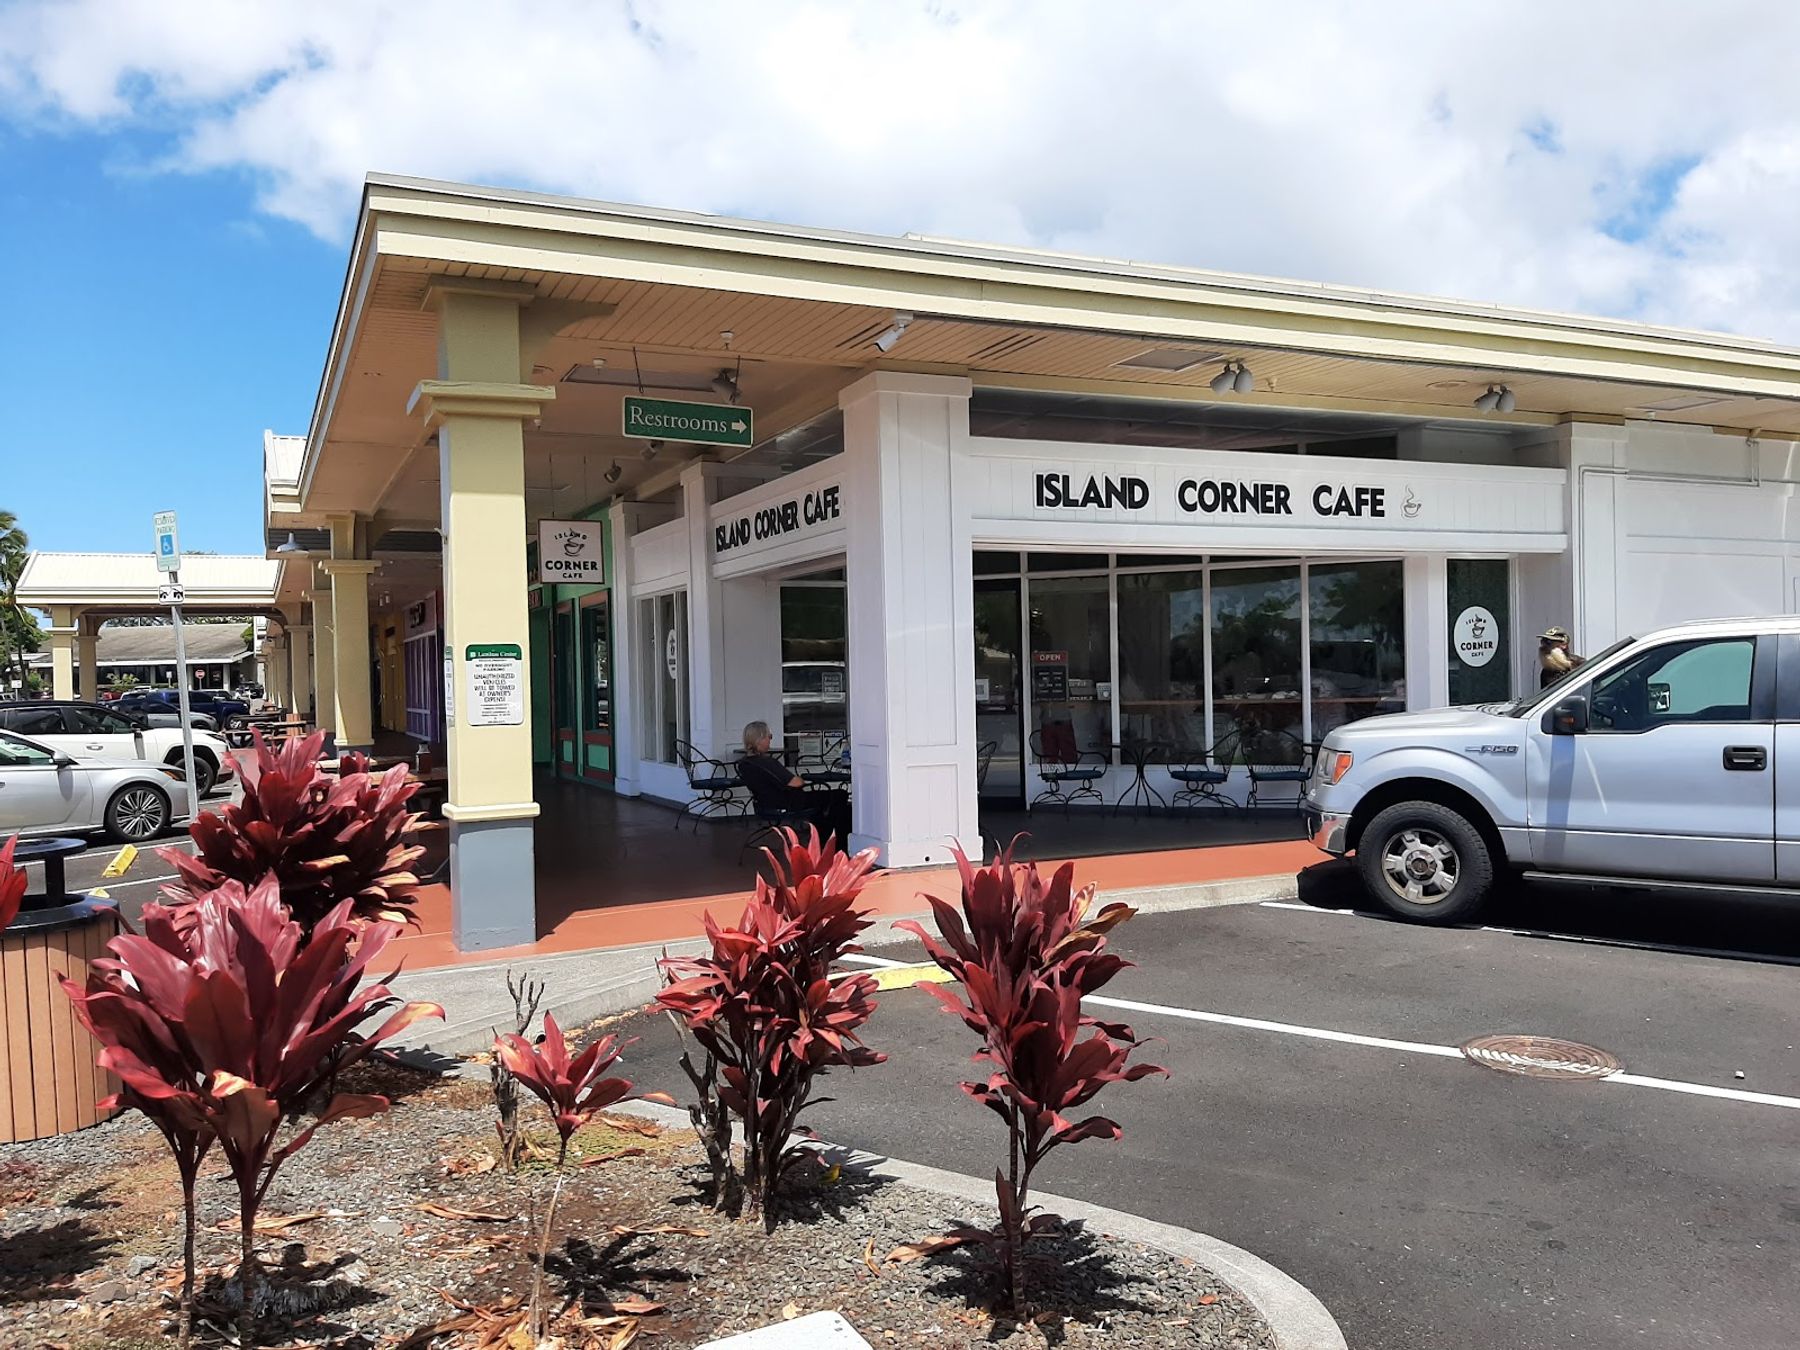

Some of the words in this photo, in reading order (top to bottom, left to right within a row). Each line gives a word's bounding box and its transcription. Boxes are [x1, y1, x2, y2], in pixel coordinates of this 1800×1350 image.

[630, 406, 727, 432] Restrooms
[1036, 474, 1149, 509] ISLAND
[1178, 480, 1292, 514] CORNER
[1312, 485, 1385, 517] CAFE
[715, 518, 751, 553] ISLAND
[755, 501, 800, 541] CORNER
[804, 485, 840, 525] CAFE
[554, 531, 588, 540] ISLAND
[545, 560, 598, 571] CORNER
[1460, 641, 1494, 651] CORNER
